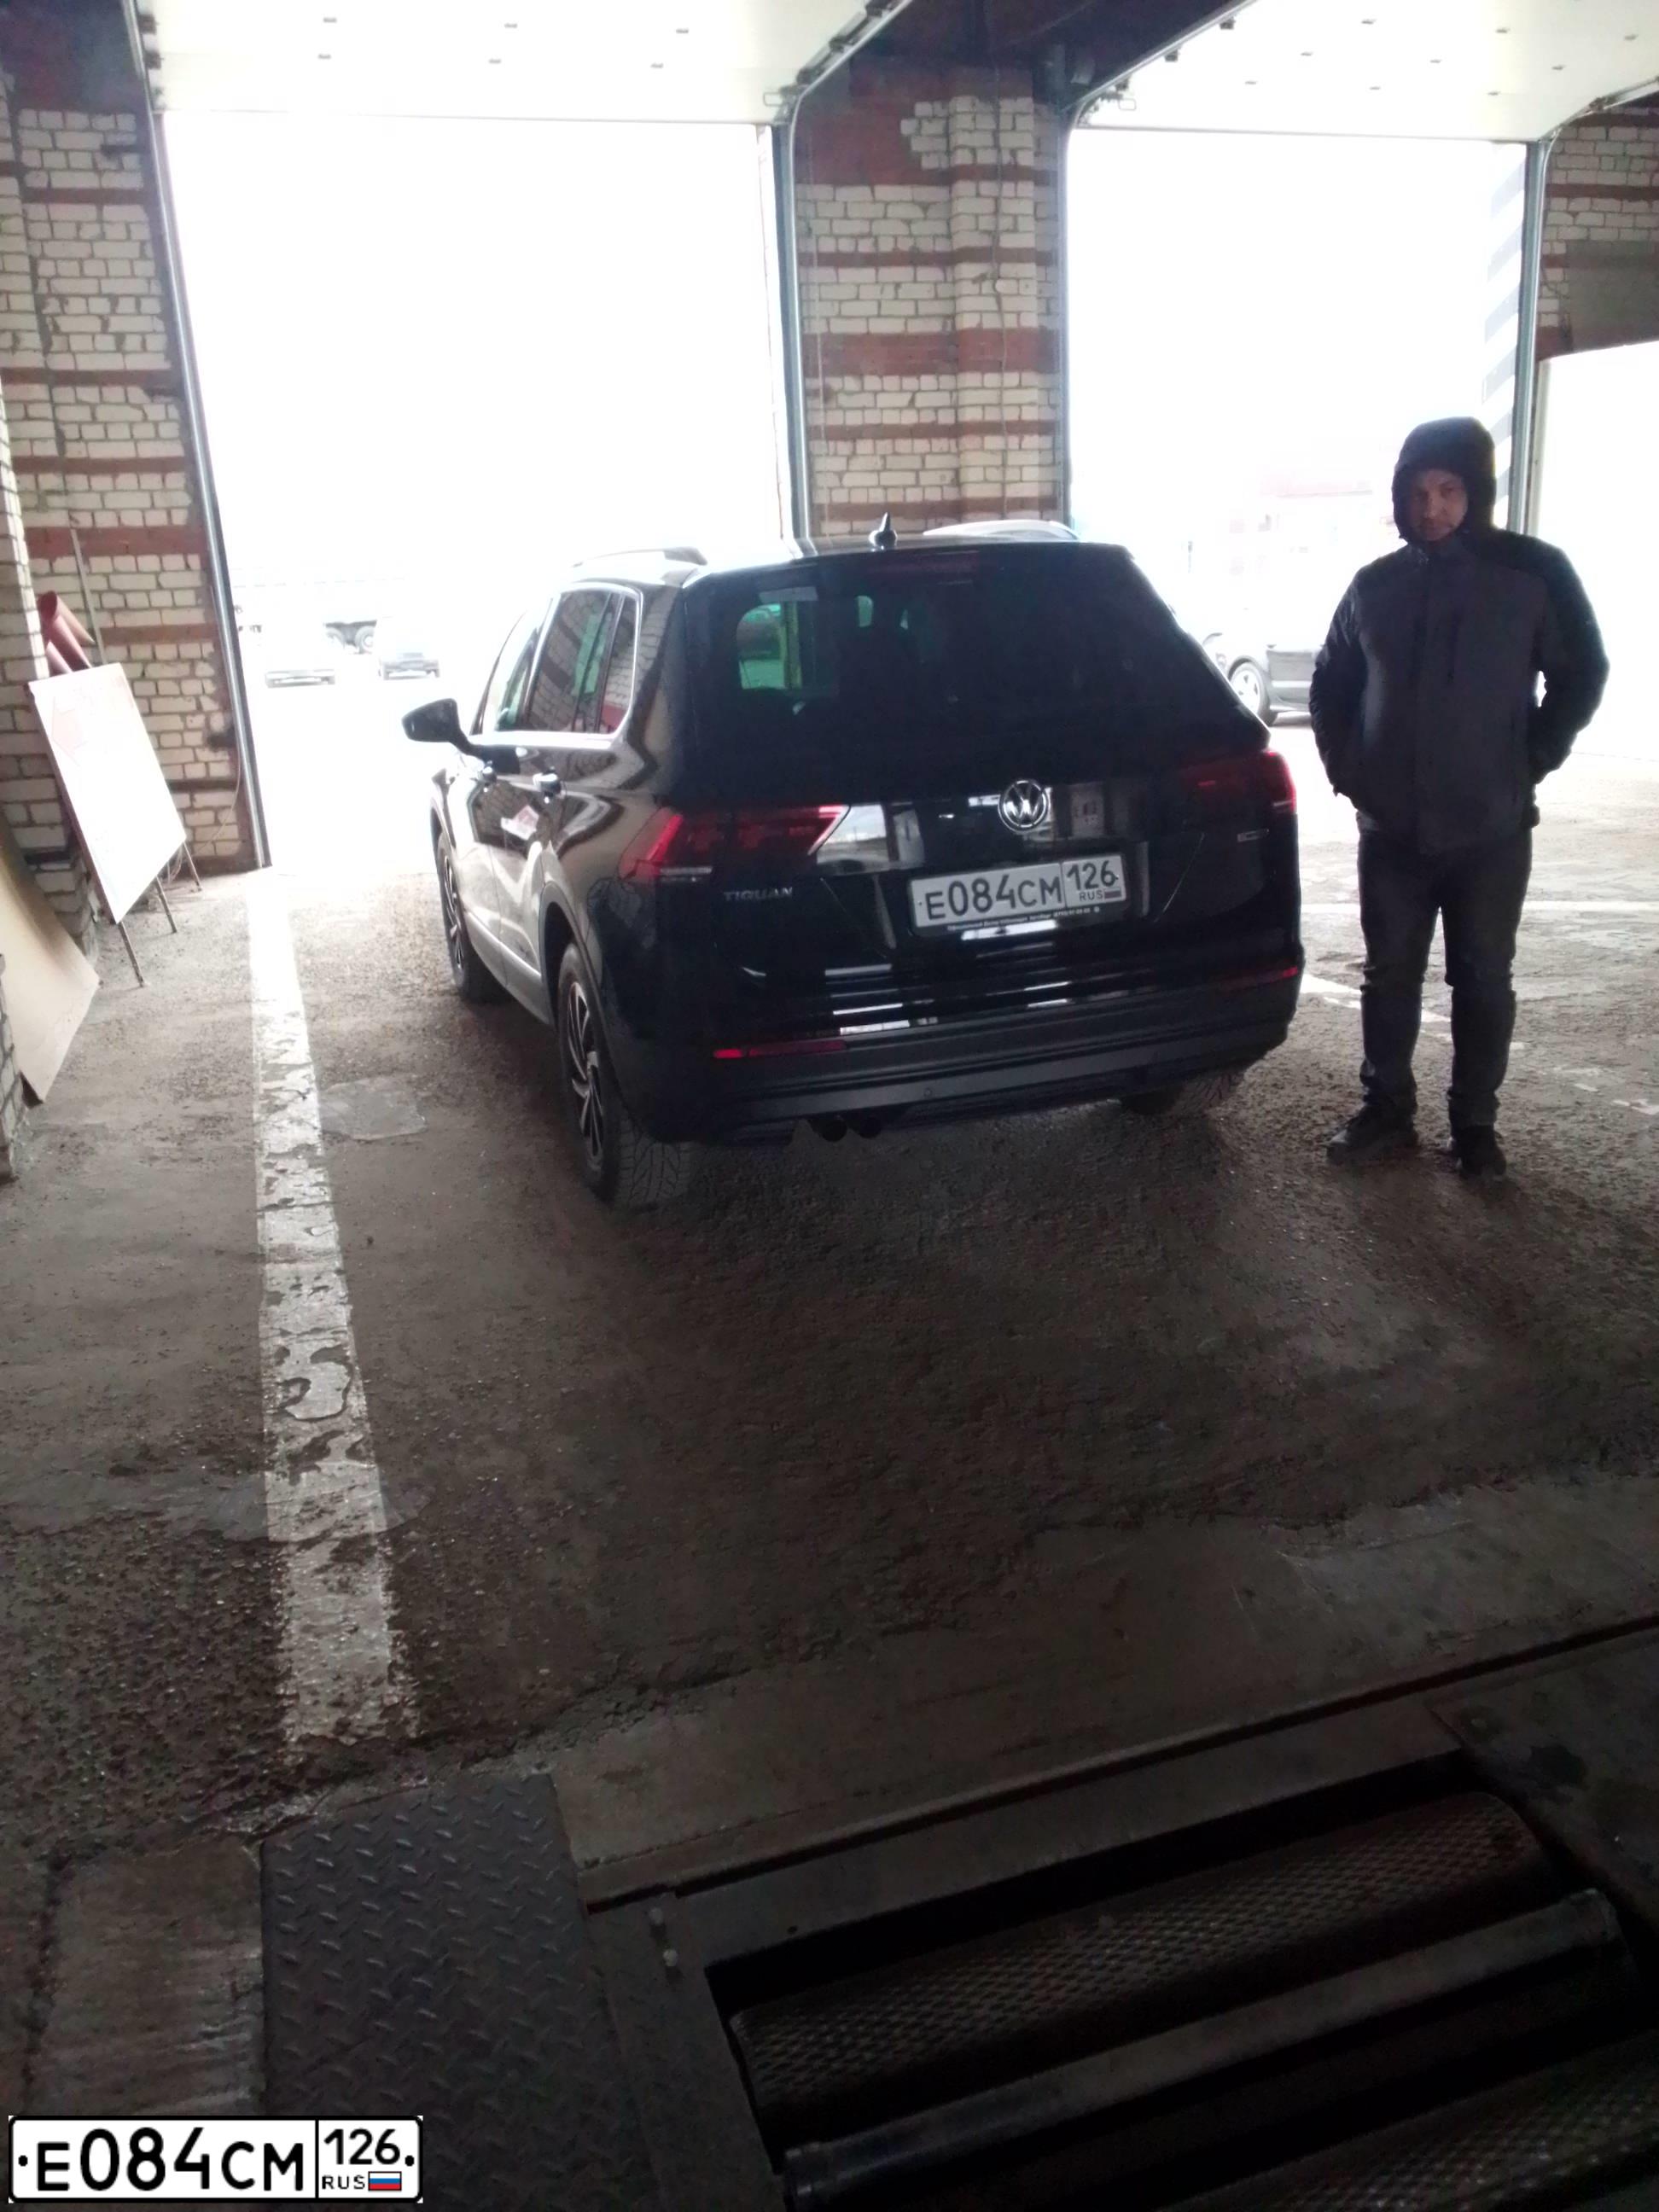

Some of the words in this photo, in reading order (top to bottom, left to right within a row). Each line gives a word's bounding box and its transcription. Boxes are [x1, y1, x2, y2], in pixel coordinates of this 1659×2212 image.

[925, 874, 1062, 920] E084CM
[1067, 859, 1115, 890] 126
[1079, 891, 1103, 901] RUS
